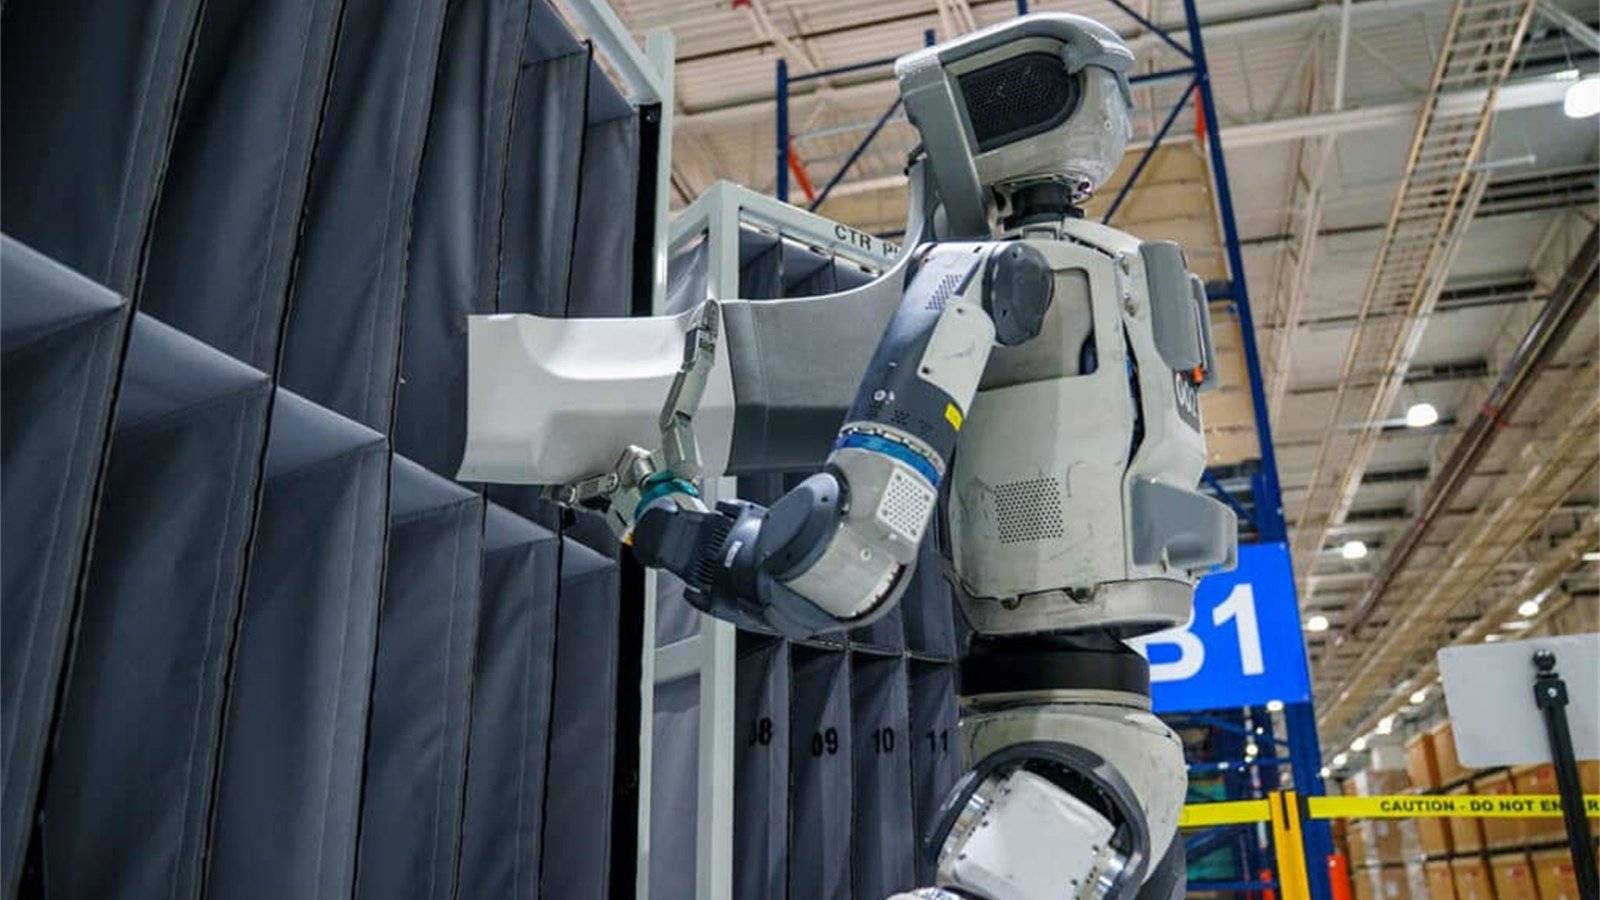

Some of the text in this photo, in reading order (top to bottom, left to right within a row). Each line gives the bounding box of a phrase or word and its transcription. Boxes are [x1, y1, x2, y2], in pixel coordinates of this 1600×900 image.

[835, 225, 871, 252] CTR
[1121, 583, 1265, 682] B1
[811, 727, 839, 757] 09
[871, 727, 895, 754] 10
[926, 729, 949, 752] 11
[1380, 800, 1455, 813] CAUTION
[1470, 800, 1494, 812] DO
[1499, 800, 1535, 812] NOT
[1541, 800, 1599, 812] ENR
